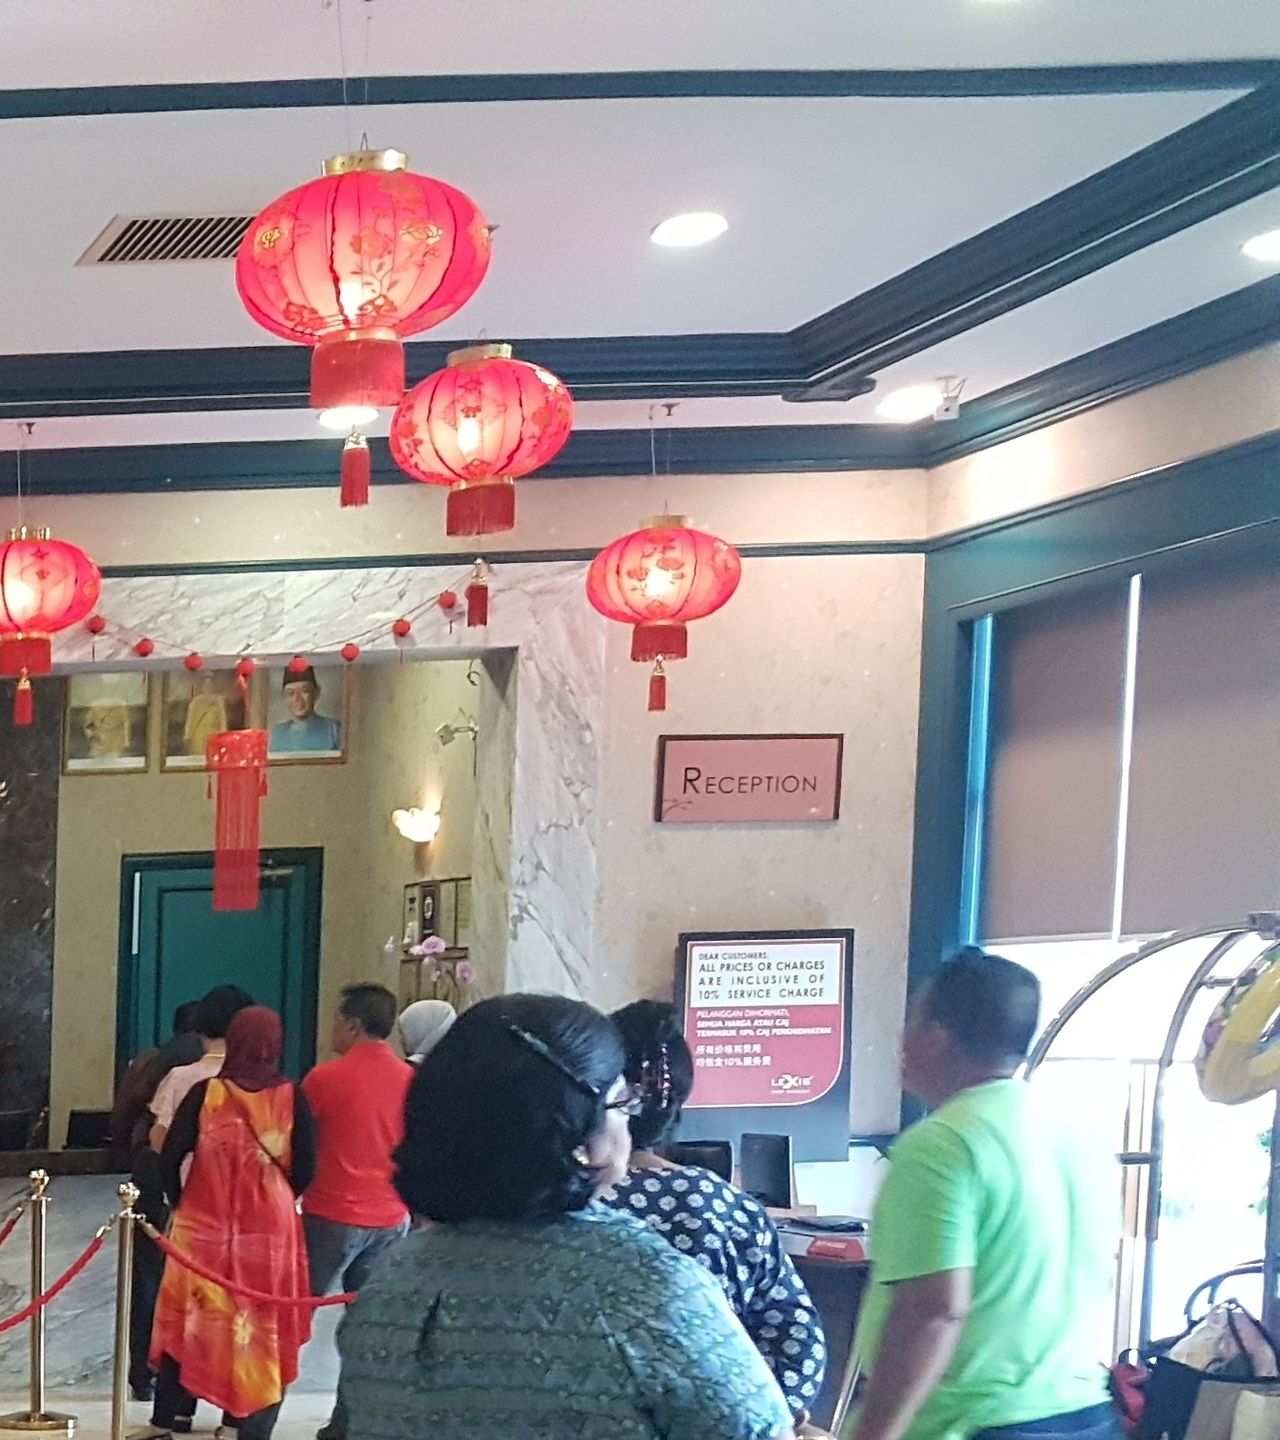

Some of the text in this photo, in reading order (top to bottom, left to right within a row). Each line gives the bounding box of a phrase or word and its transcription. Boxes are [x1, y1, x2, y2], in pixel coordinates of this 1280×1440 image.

[699, 961, 825, 972] ALL PRICES OR CHARGES
[699, 974, 825, 986] ARE INCLUSIVE OF
[699, 988, 824, 1000] 10% SERVICE CHARGE
